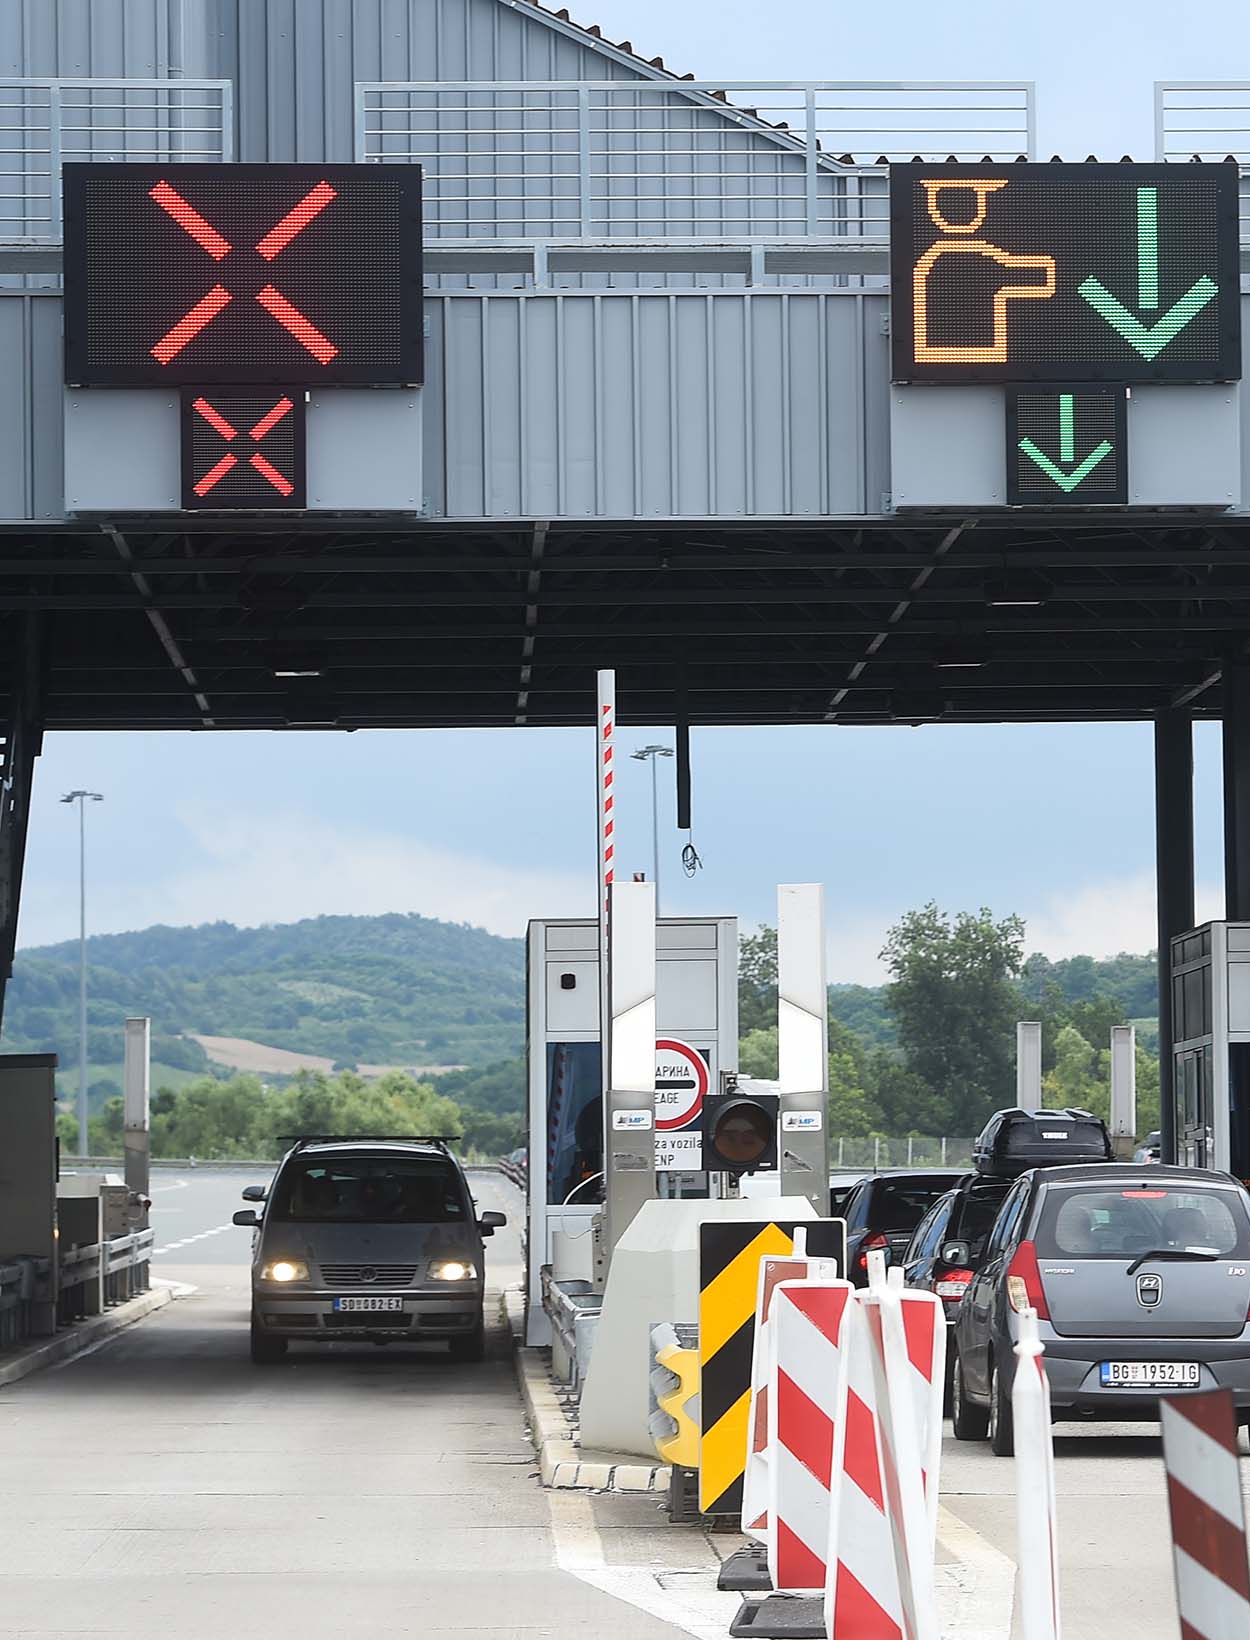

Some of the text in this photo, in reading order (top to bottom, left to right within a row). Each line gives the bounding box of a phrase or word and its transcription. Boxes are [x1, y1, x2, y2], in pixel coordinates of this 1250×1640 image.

[655, 1065, 690, 1077] АРИНА
[654, 1092, 680, 1104] EAGE
[670, 1137, 702, 1149] vozila
[1112, 1364, 1129, 1379] BG
